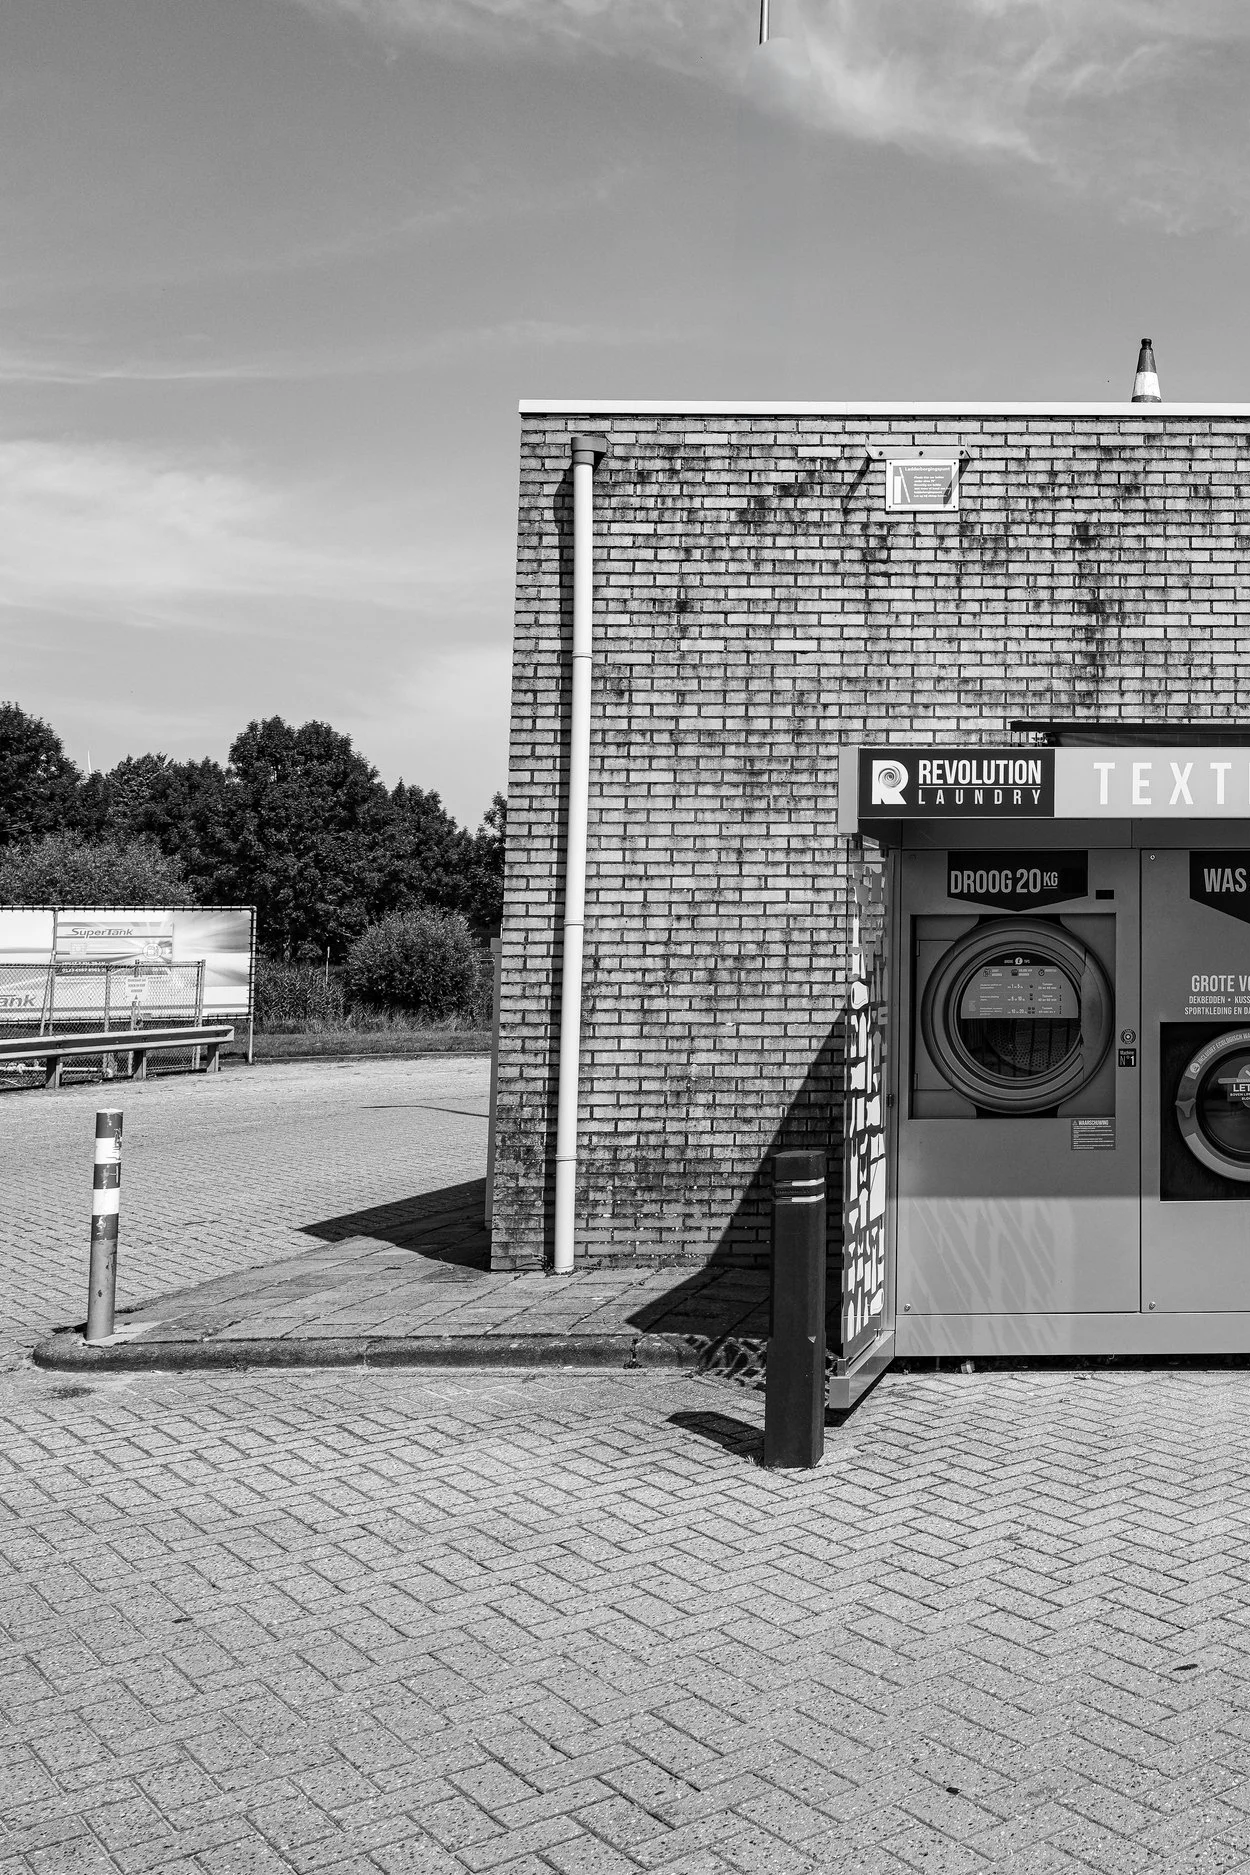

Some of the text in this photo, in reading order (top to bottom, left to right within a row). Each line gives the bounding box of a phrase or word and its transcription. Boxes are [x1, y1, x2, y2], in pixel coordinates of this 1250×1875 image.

[918, 759, 1041, 785] REVOLUTION
[918, 789, 1041, 805] LAUNDRY
[950, 868, 1058, 894] DROOG 20 KG
[1203, 868, 1247, 893] WAS
[66, 928, 134, 938] SuperTank
[1191, 975, 1235, 992] GROTE
[1189, 996, 1225, 1004] DEKBEDDEN
[1184, 1006, 1232, 1015] SPORTKLEDING
[1233, 1006, 1242, 1015] EN
[1216, 1034, 1242, 1049] ECOLOGISCH
